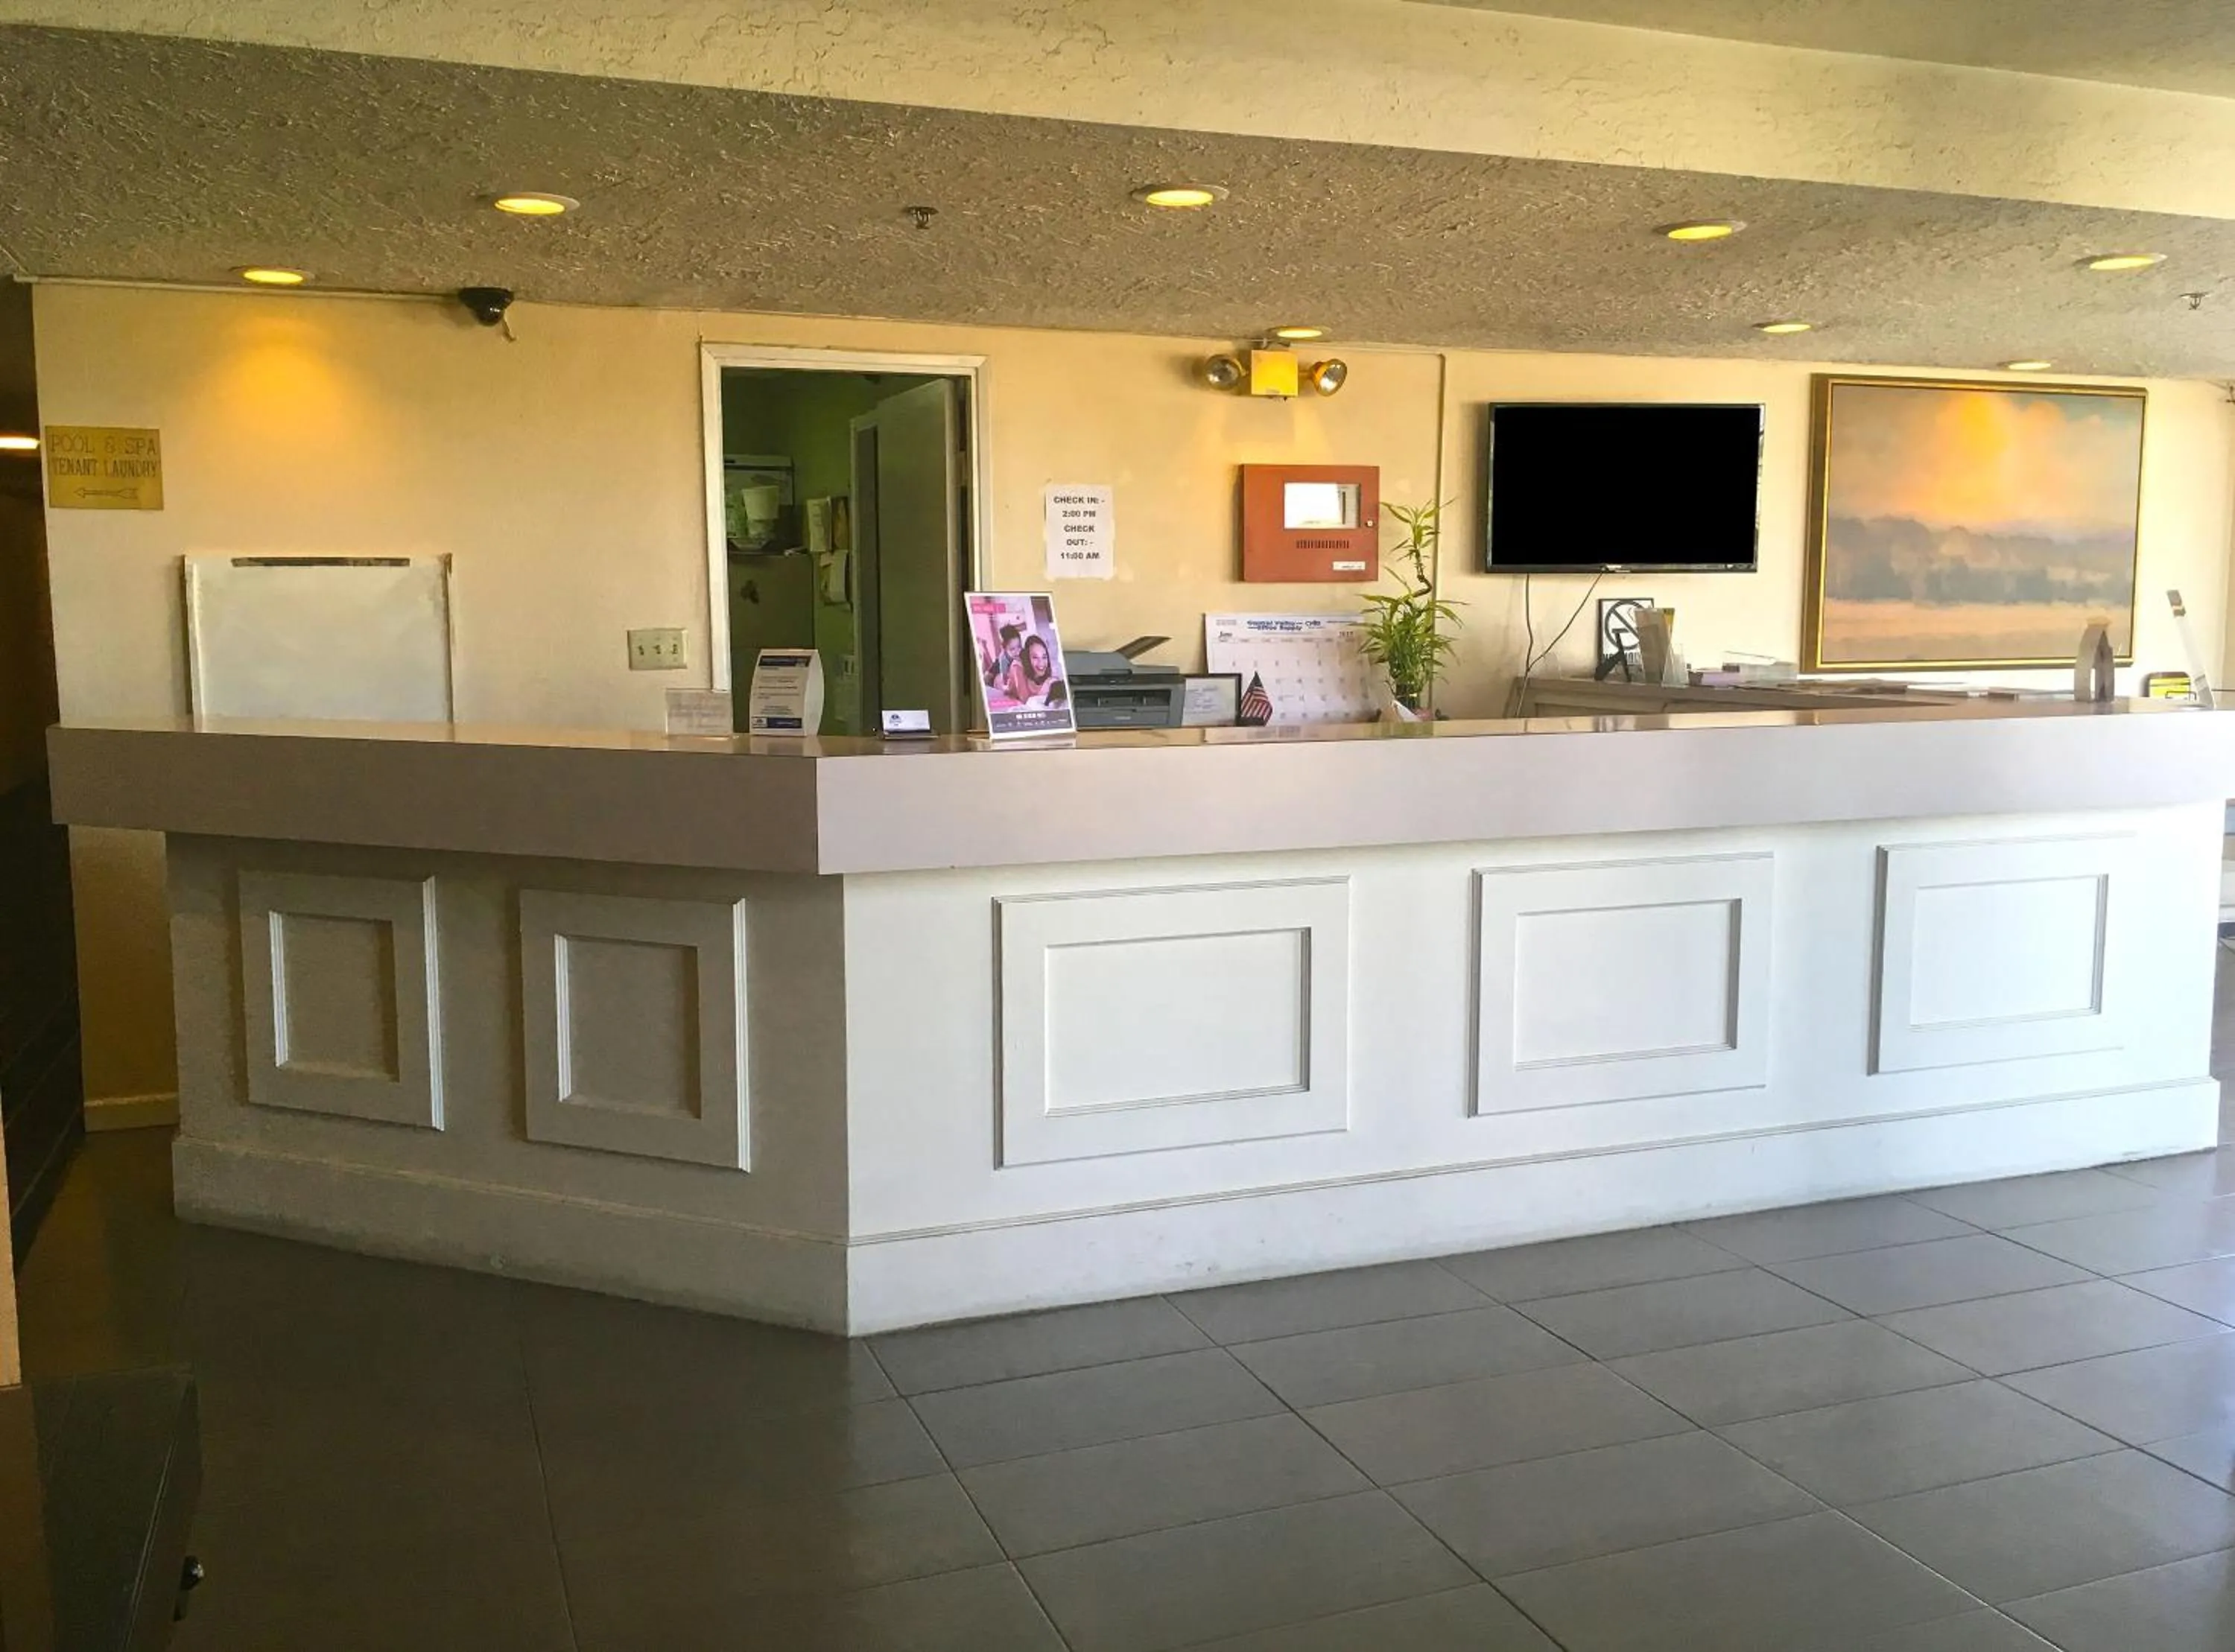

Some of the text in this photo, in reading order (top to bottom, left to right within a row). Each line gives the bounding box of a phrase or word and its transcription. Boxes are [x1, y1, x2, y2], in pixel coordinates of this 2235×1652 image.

[50, 434, 95, 453] POOL
[125, 436, 157, 455] SPA
[52, 457, 157, 478] TENANT LAUNDRY
[1053, 496, 1085, 504] CHECK
[1064, 524, 1095, 533] CHECK
